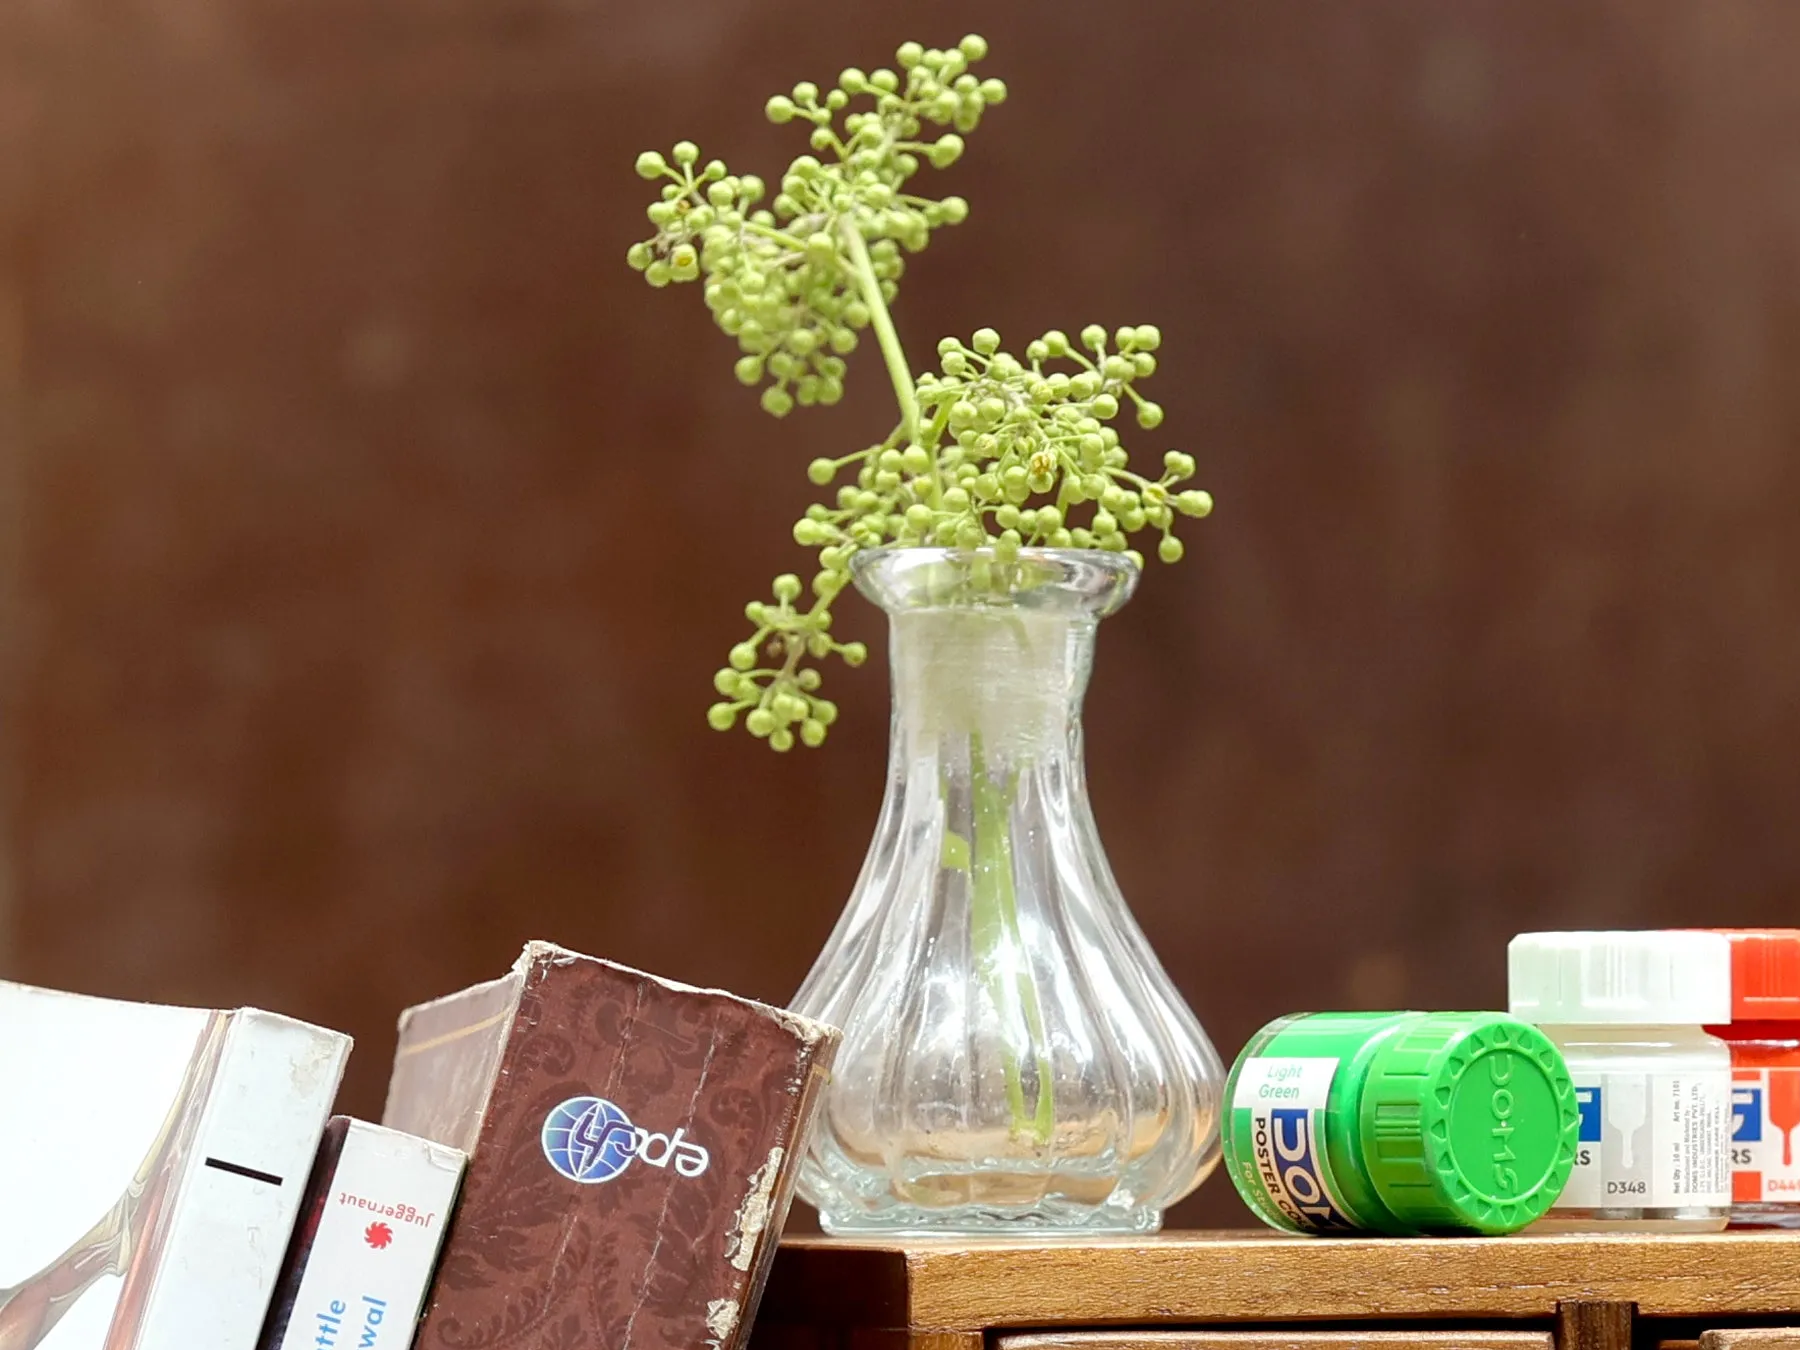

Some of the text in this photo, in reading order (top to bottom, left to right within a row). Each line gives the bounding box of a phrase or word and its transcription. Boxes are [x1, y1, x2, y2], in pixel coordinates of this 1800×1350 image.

[1267, 1065, 1303, 1082] Light
[1258, 1084, 1300, 1100] Green
[1254, 1117, 1281, 1194] POSTER
[1606, 1181, 1647, 1194] D348
[339, 1192, 436, 1229] juggernaut
